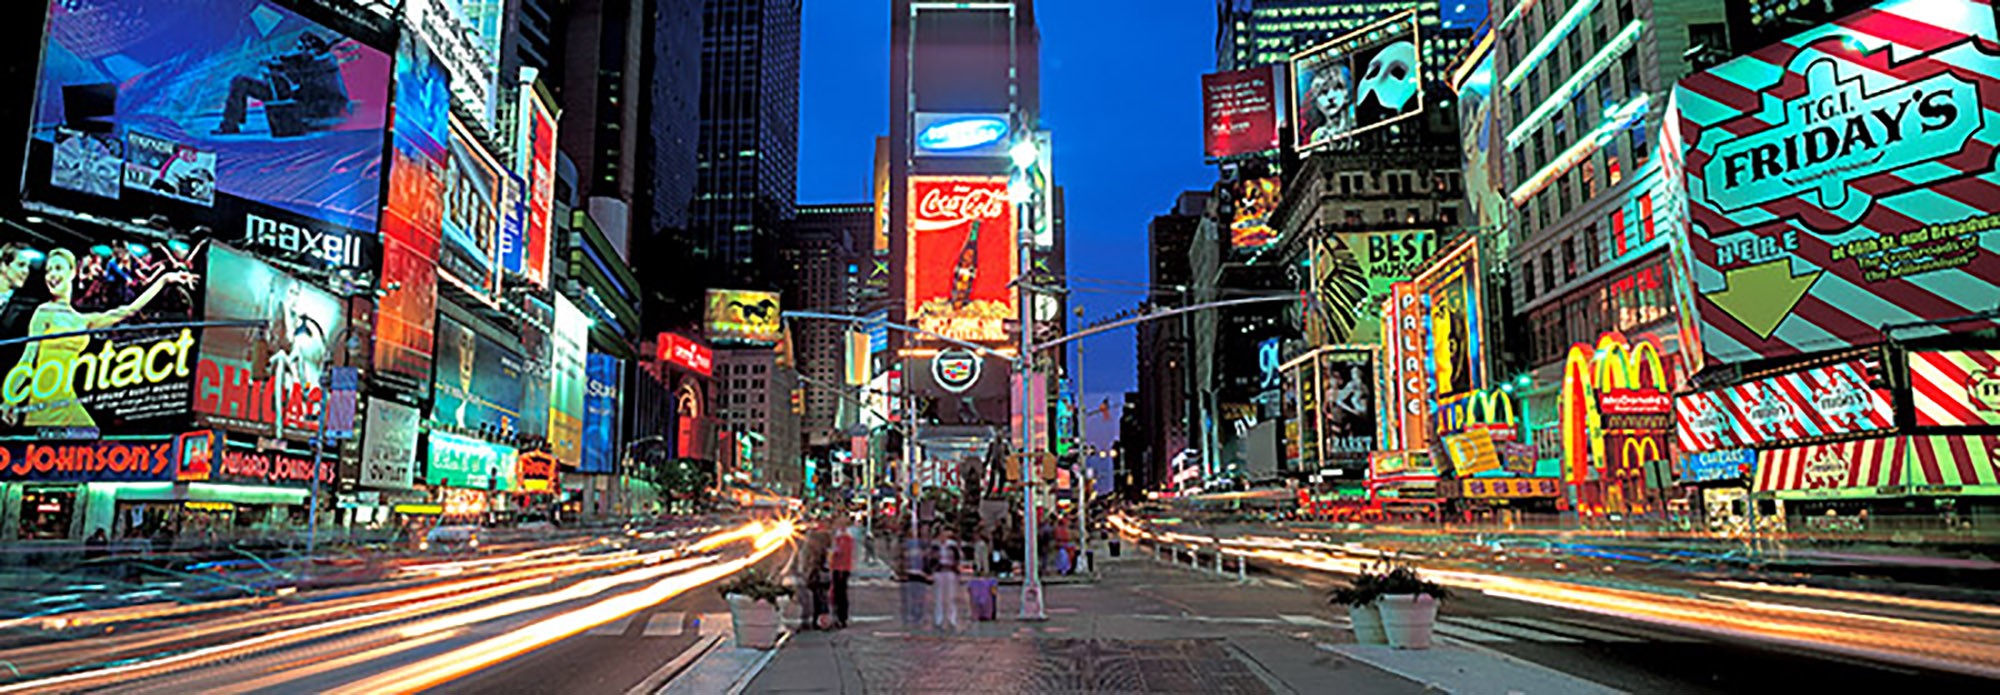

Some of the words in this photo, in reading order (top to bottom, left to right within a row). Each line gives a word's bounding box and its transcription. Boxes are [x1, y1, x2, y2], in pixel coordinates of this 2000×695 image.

[1798, 91, 1855, 125] T.G.I.
[1723, 89, 1958, 189] FRIDAY'S
[246, 213, 361, 267] maxell
[1369, 232, 1434, 262] BEST
[1717, 230, 1799, 266] HERE
[1900, 227, 1929, 246] and
[3, 328, 195, 406] contact
[1401, 293, 1421, 415] PALACE
